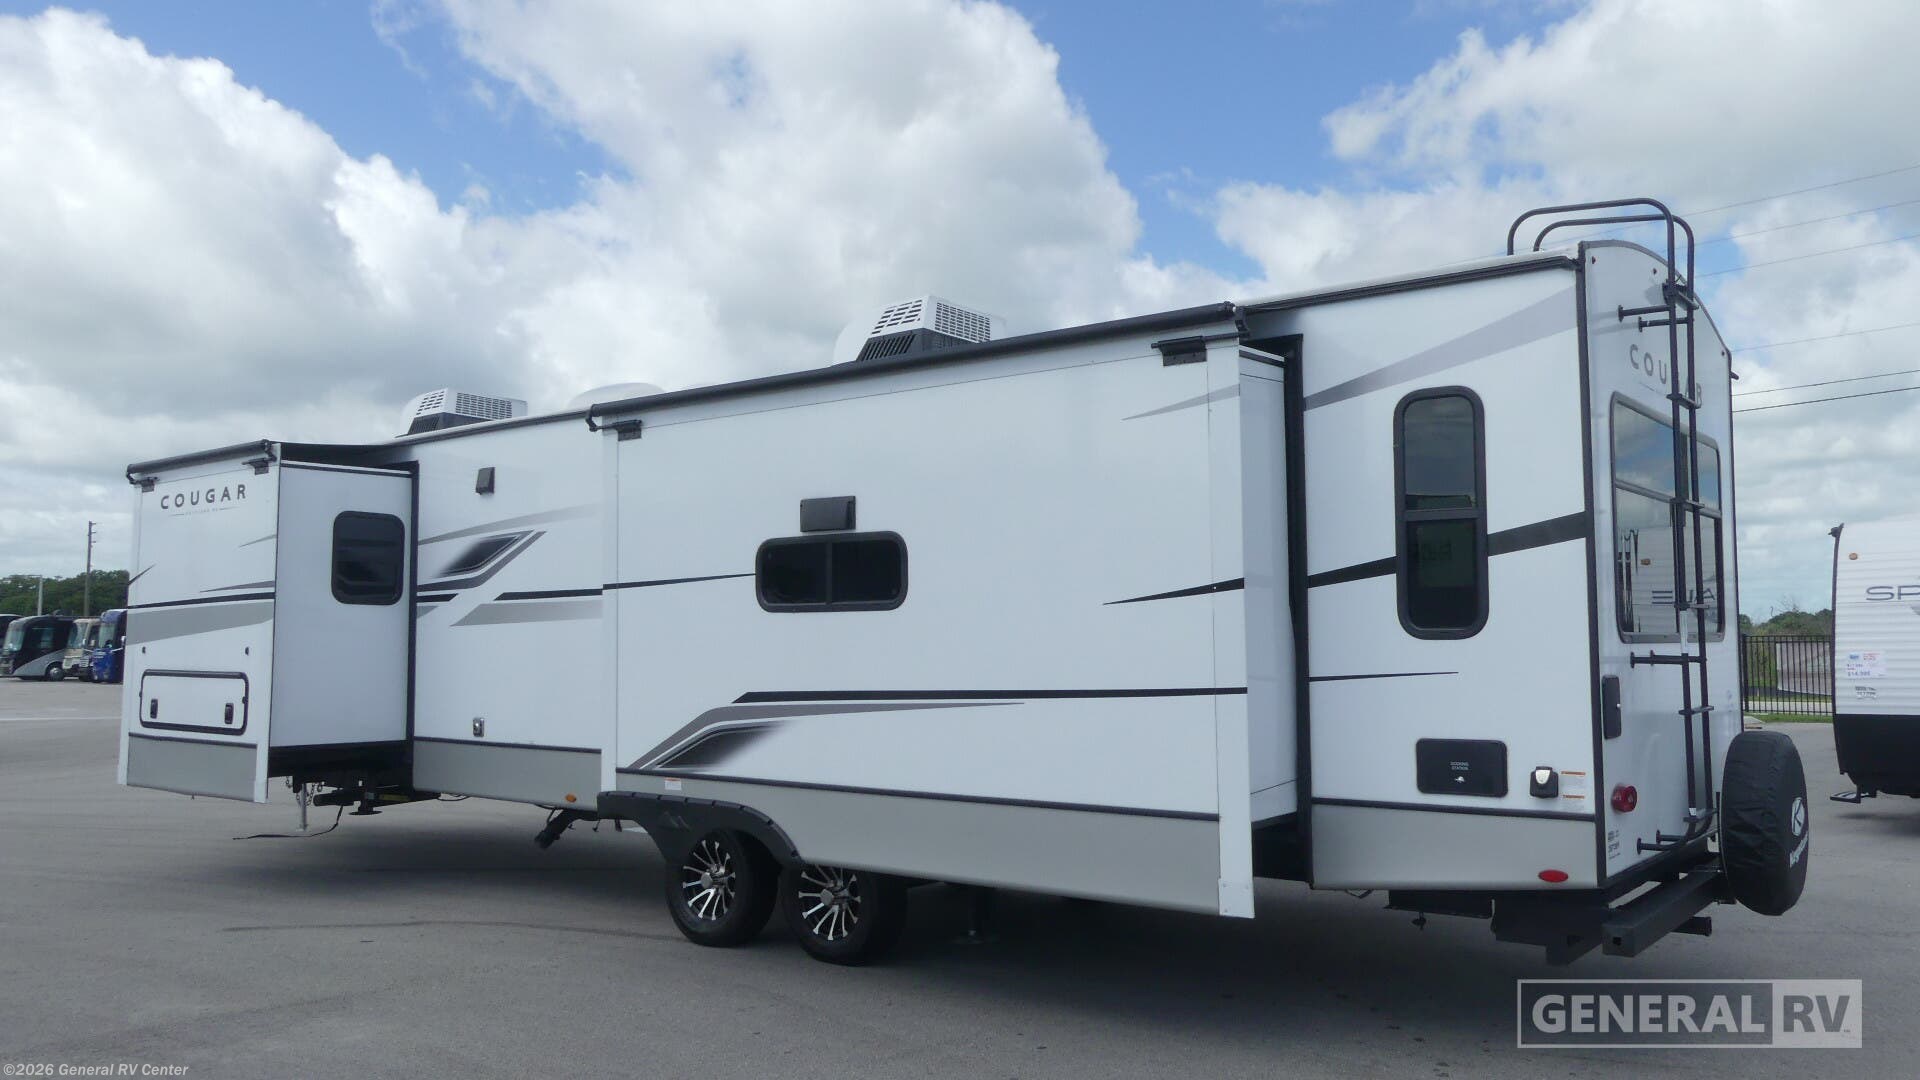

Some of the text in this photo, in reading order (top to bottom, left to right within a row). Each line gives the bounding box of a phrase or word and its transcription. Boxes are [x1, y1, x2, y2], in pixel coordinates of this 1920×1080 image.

[1629, 343, 1703, 409] COUR
[160, 484, 247, 510] COUGAR
[1865, 585, 1920, 601] SP
